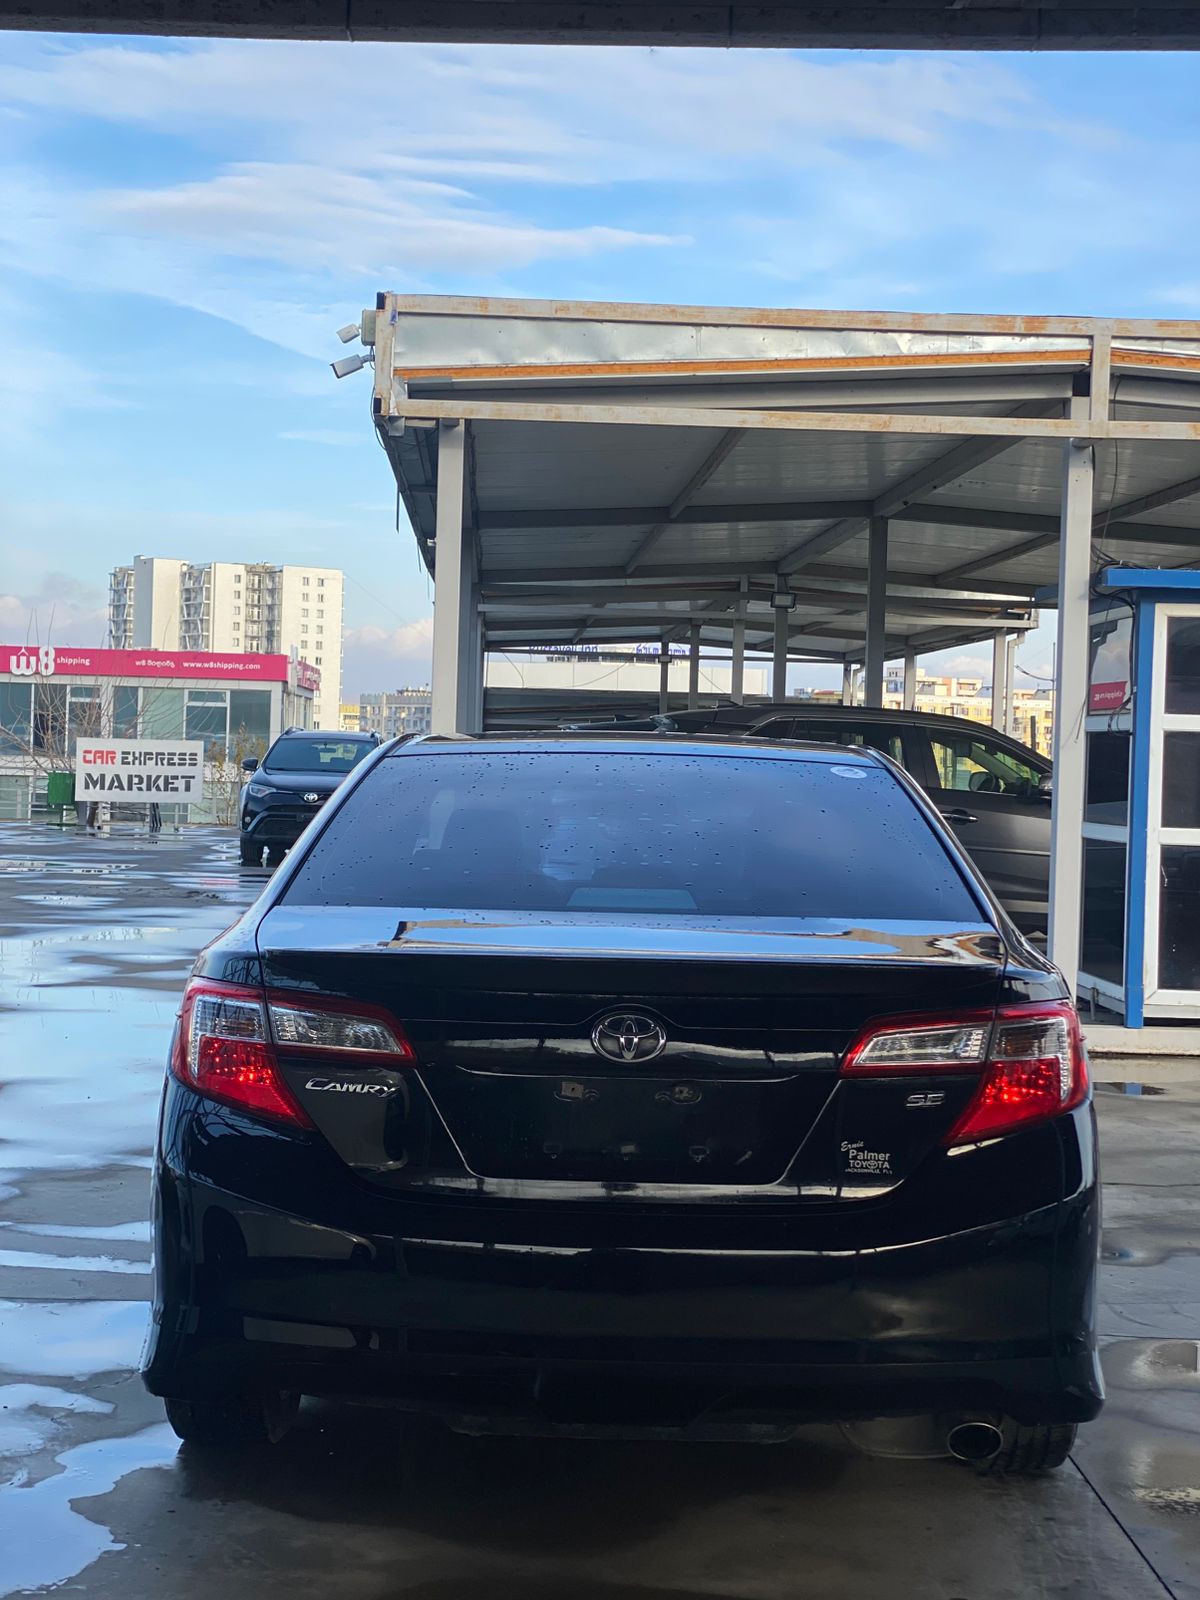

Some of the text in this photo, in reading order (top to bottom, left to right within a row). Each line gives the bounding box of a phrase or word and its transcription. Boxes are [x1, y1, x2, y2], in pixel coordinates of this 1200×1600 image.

[57, 657, 90, 666] shipping
[183, 661, 261, 670] www.w8shipping.com
[82, 749, 198, 766] CAR EXPRESS
[84, 773, 195, 792] MARKET
[305, 1078, 398, 1097] CAMRY
[906, 1093, 944, 1107] SE
[849, 1150, 890, 1160] Palmer
[849, 1160, 890, 1169] TOYOTA
